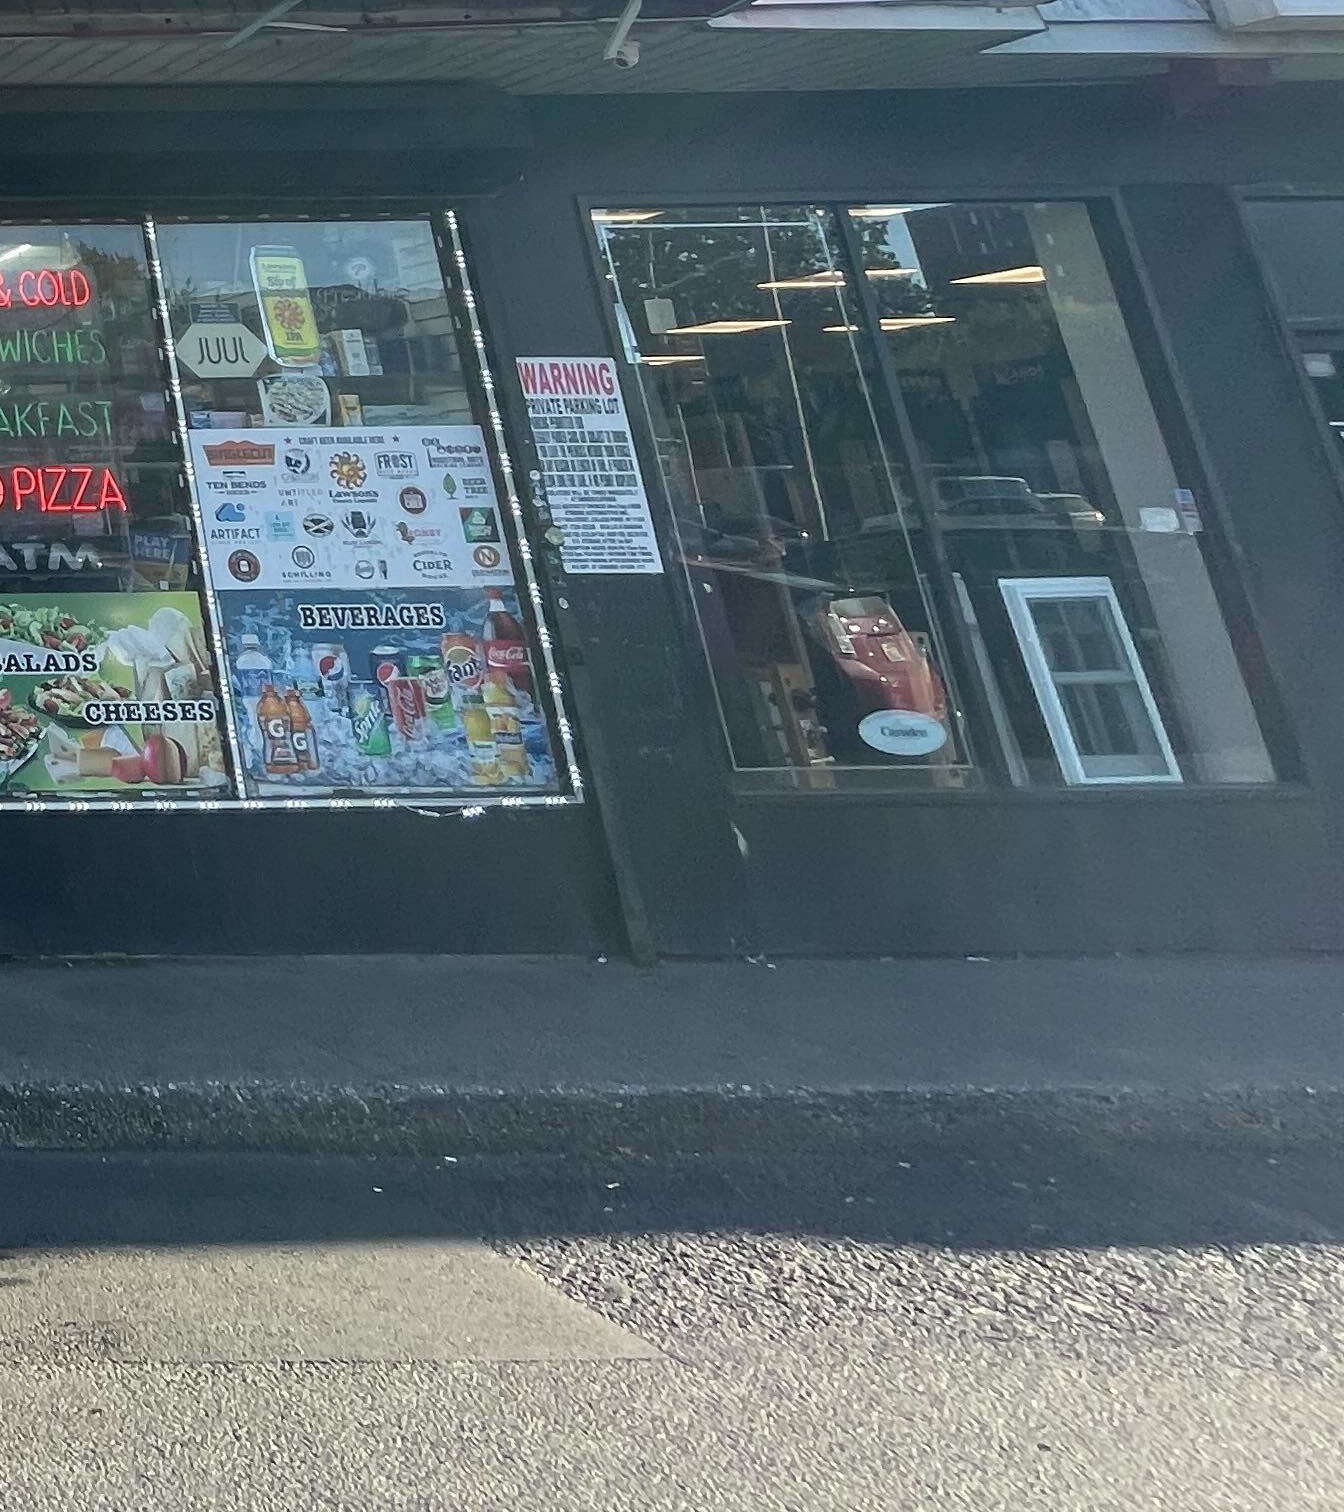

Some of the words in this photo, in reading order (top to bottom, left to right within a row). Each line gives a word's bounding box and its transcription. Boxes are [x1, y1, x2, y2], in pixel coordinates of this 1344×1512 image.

[19, 269, 91, 307] COLD
[198, 336, 249, 365] JUUL
[518, 362, 615, 395] WARNING
[12, 468, 128, 512] PIZZA
[135, 535, 169, 548] PLAY
[211, 529, 260, 539] ARTIFACT
[413, 560, 453, 571] CIDER
[300, 605, 444, 627] BEVERAGES
[85, 701, 213, 724] CHEESES
[268, 719, 284, 737] G
[293, 733, 306, 751] G
